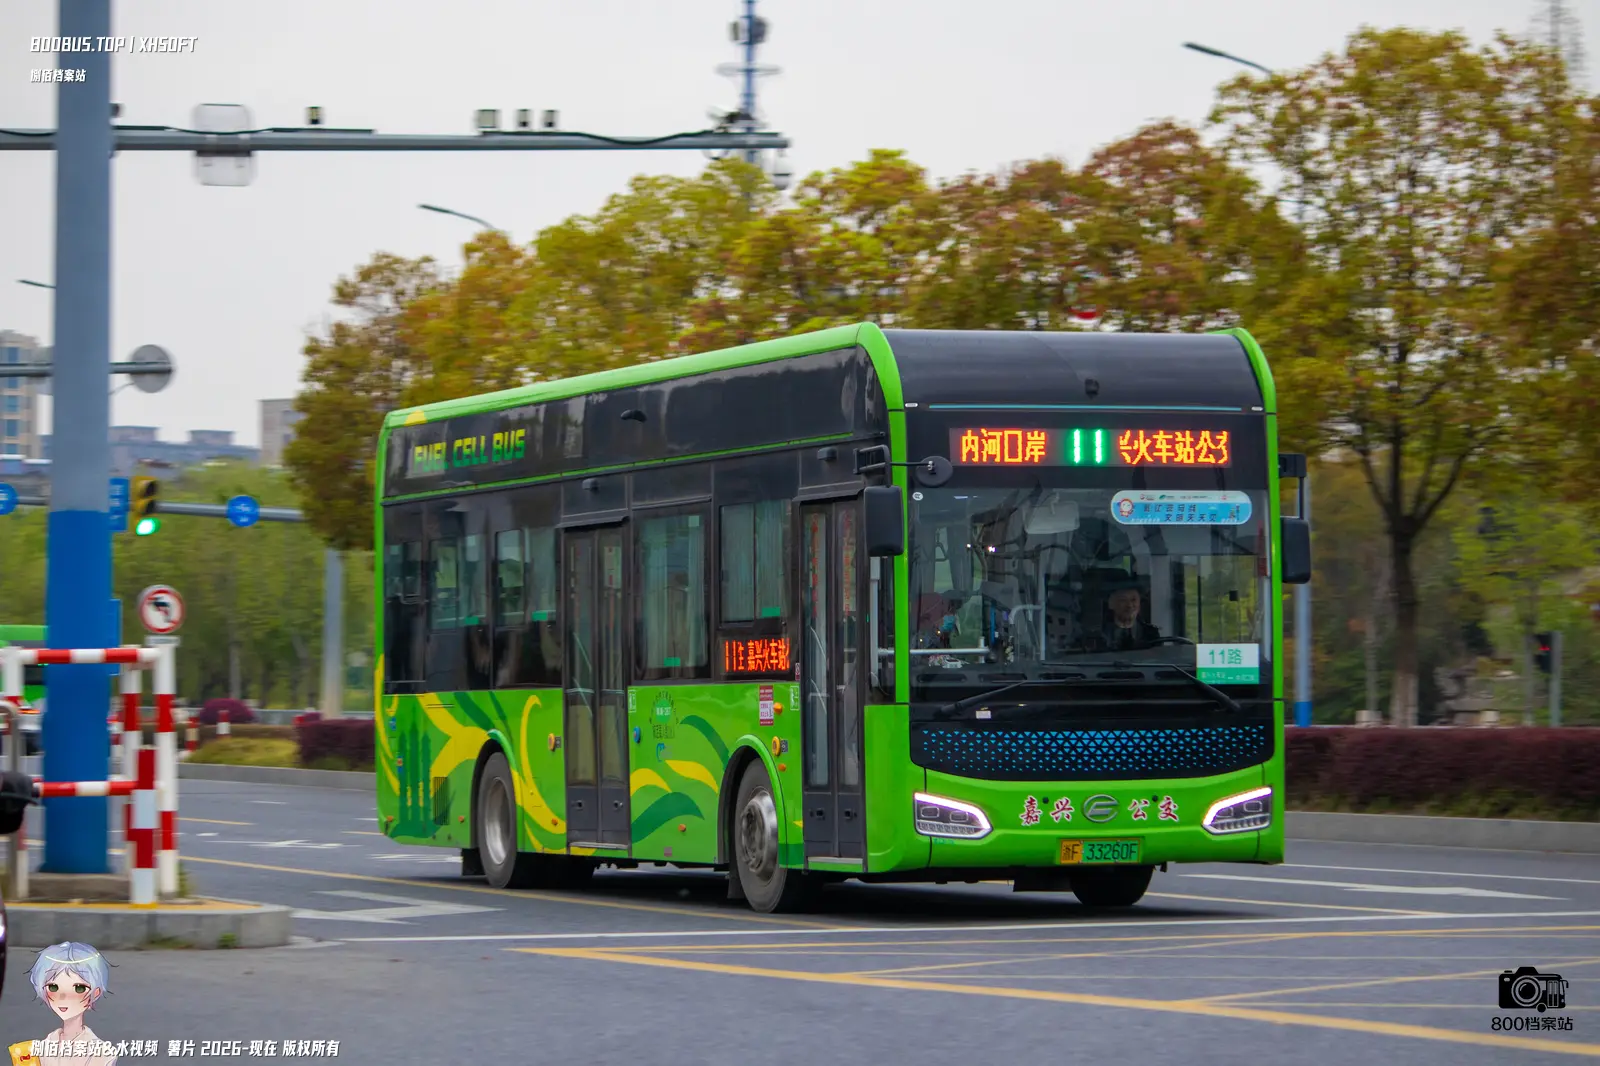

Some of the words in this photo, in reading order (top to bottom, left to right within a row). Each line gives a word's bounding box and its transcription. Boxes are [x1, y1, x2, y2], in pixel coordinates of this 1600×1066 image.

[413, 442, 449, 473] FUEL
[452, 435, 488, 468] CELL
[491, 428, 525, 462] BUS
[961, 428, 1046, 463] 内河口岸
[1073, 428, 1102, 464] 11
[1209, 648, 1242, 665] 11路
[1018, 795, 1074, 826] 嘉兴
[1128, 796, 1178, 822] 公交
[1086, 843, 1139, 861] 33260F
